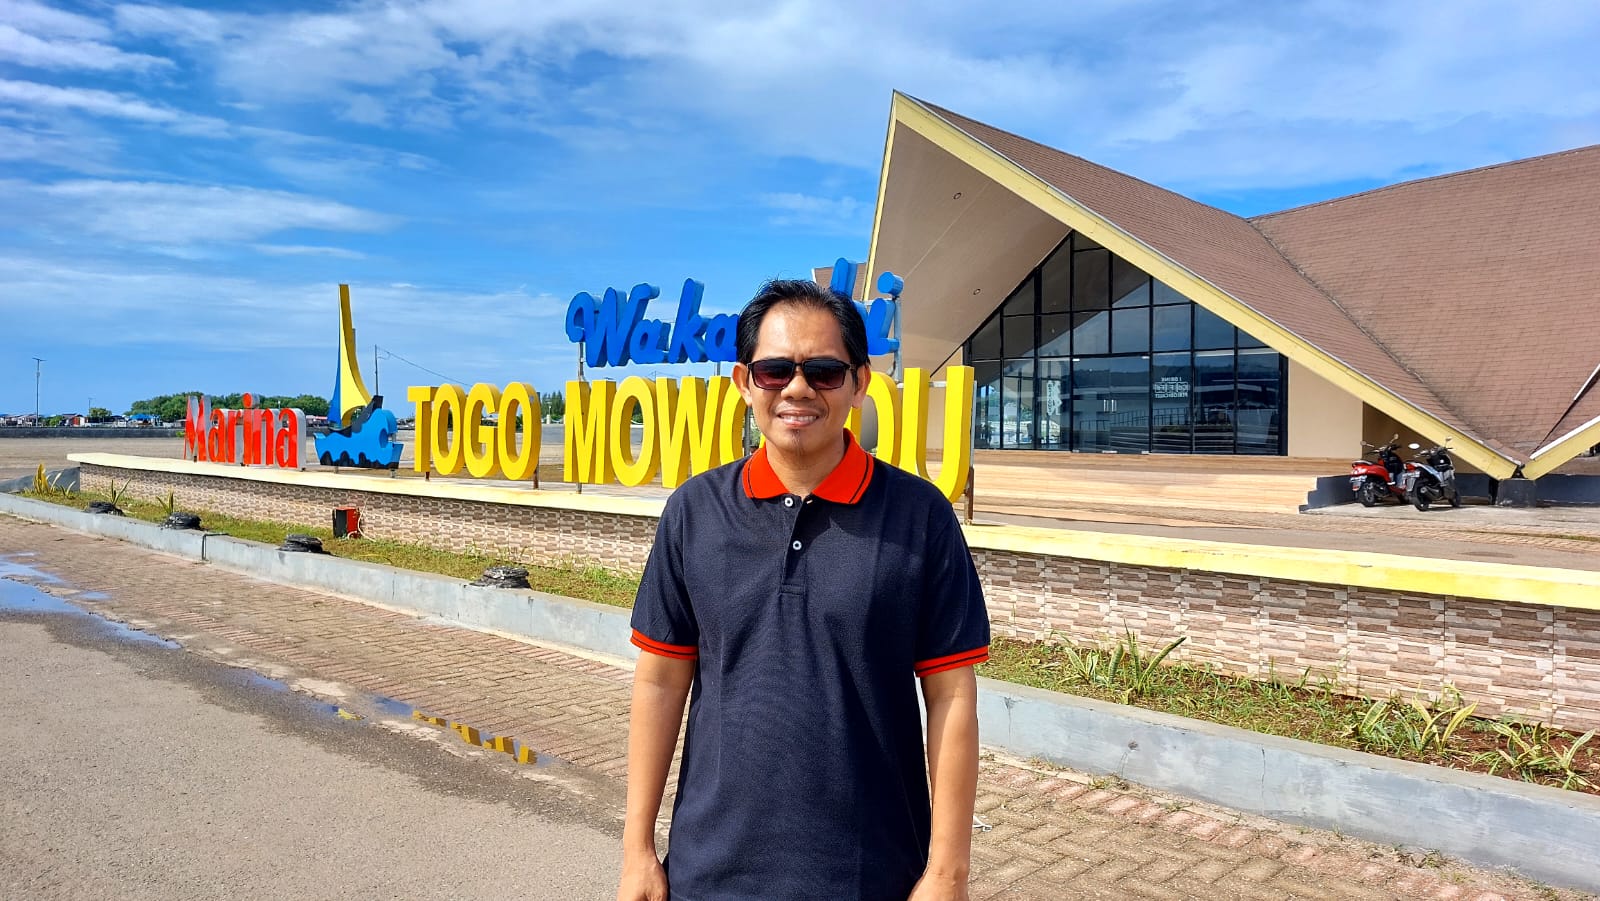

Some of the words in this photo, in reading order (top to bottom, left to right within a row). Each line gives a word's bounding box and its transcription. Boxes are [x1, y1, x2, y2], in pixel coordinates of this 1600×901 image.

[565, 257, 903, 367] Wakai
[184, 392, 306, 470] Marina
[407, 381, 542, 480] TOGO
